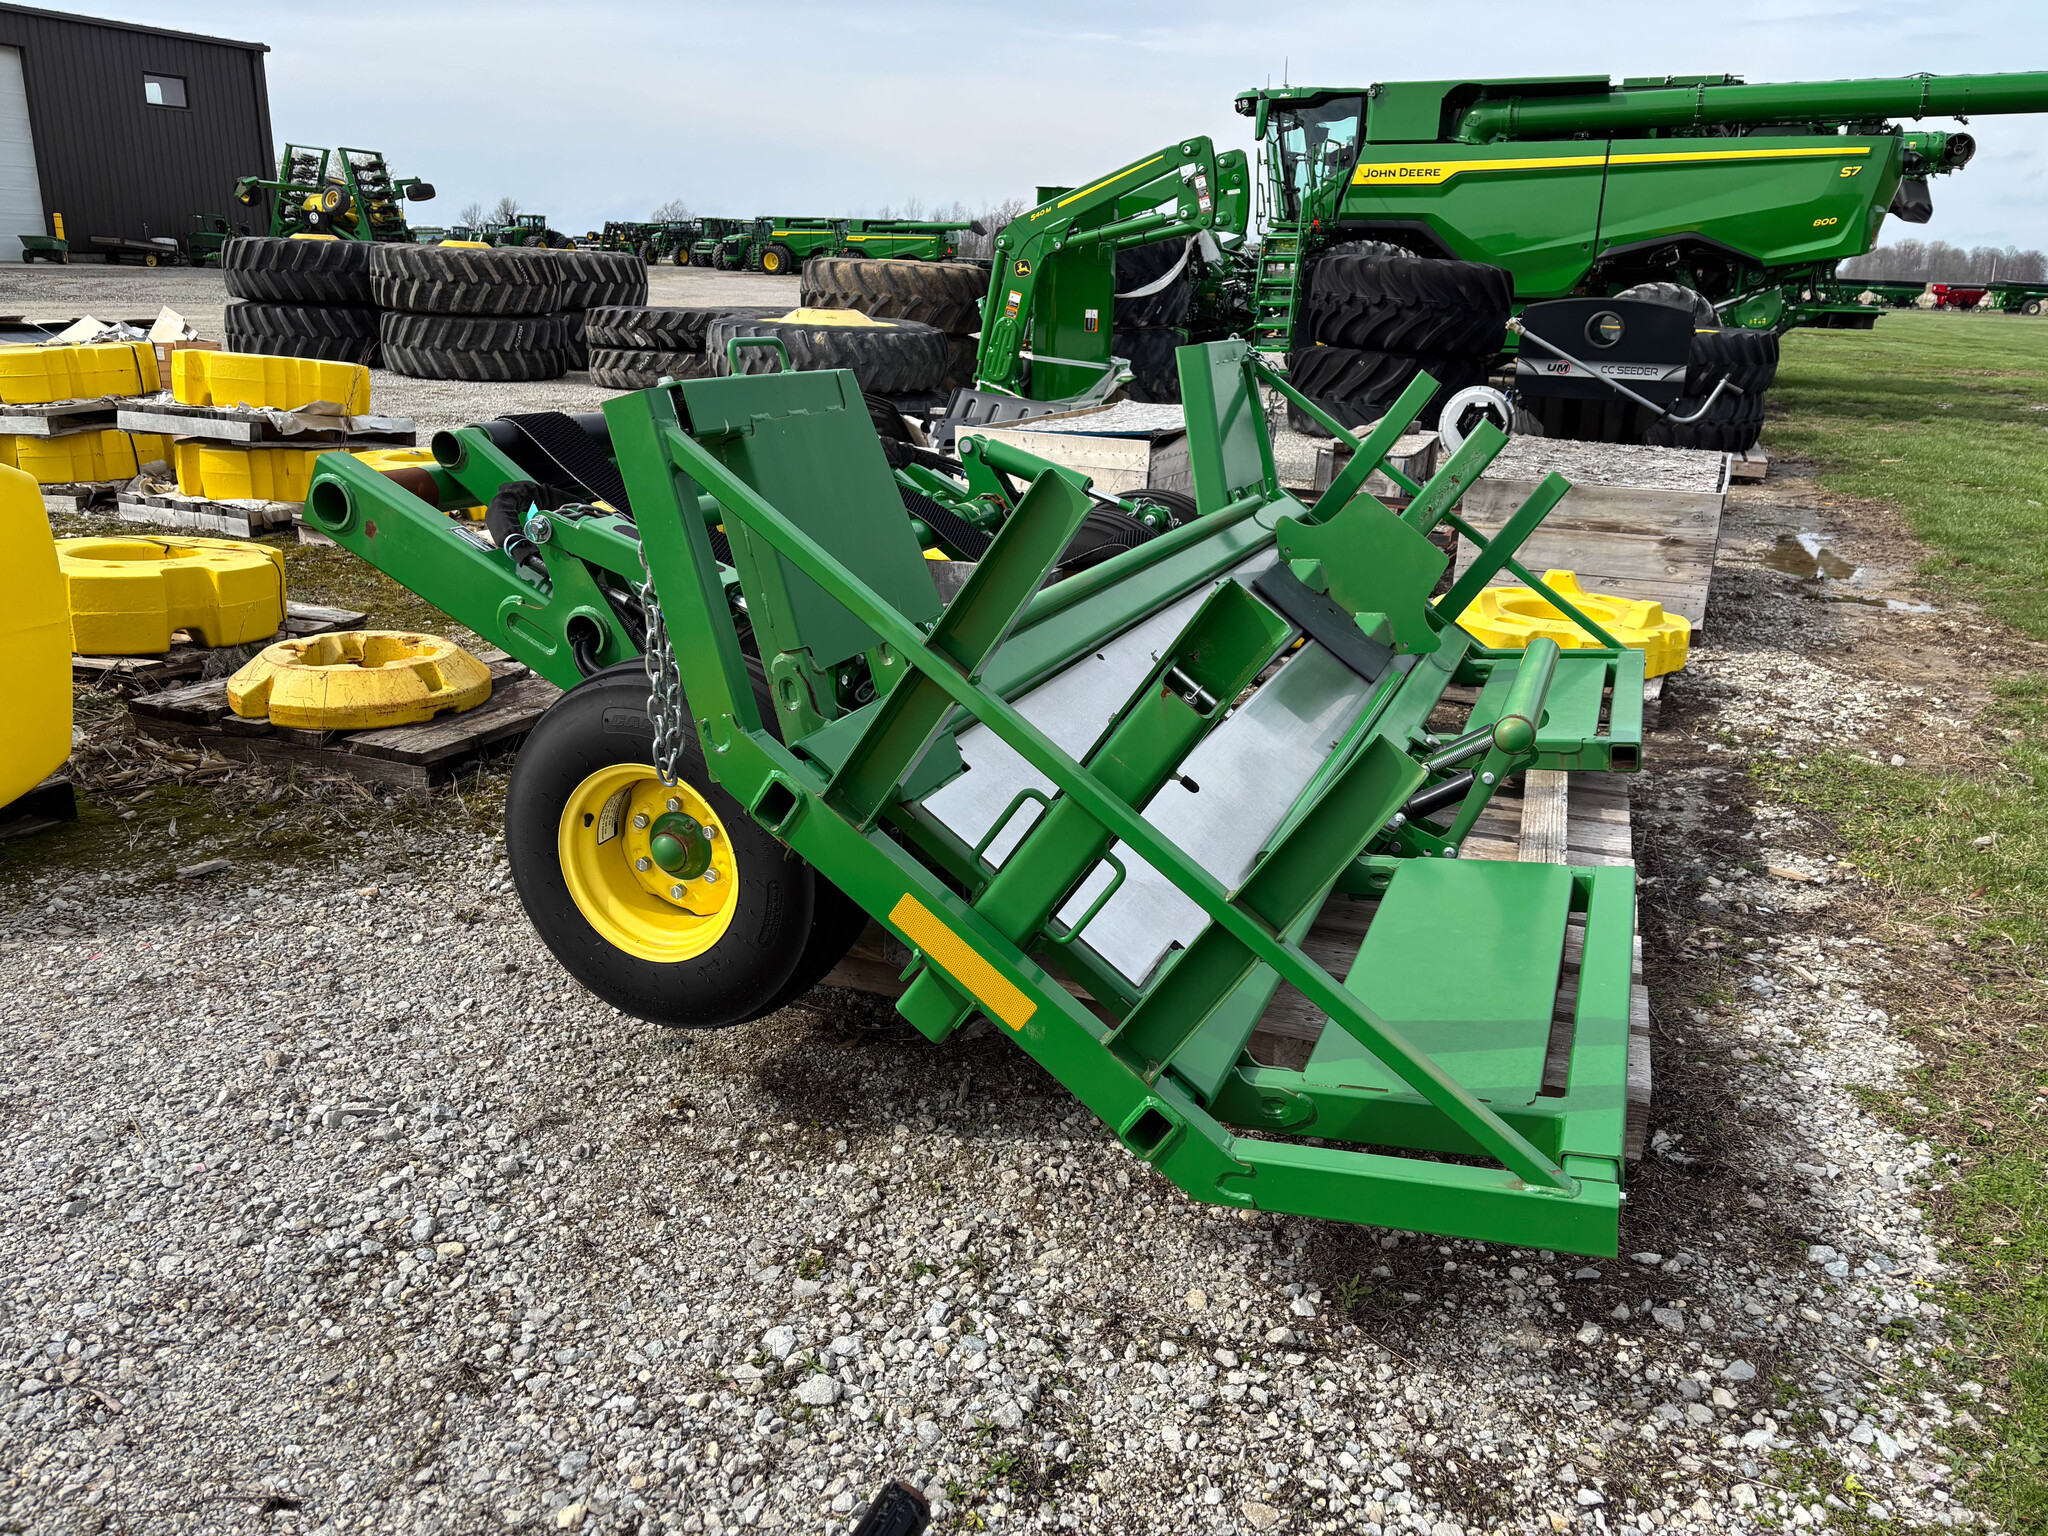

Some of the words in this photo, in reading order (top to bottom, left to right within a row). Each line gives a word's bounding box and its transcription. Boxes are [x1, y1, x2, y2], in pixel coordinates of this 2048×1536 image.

[1363, 168, 1396, 178] JOHN
[1399, 167, 1441, 177] DEERE
[1839, 165, 1863, 178] S7
[1813, 217, 1838, 227] 800
[1546, 362, 1570, 373] UM
[1600, 365, 1615, 374] CC
[1617, 366, 1659, 376] SEEDER
